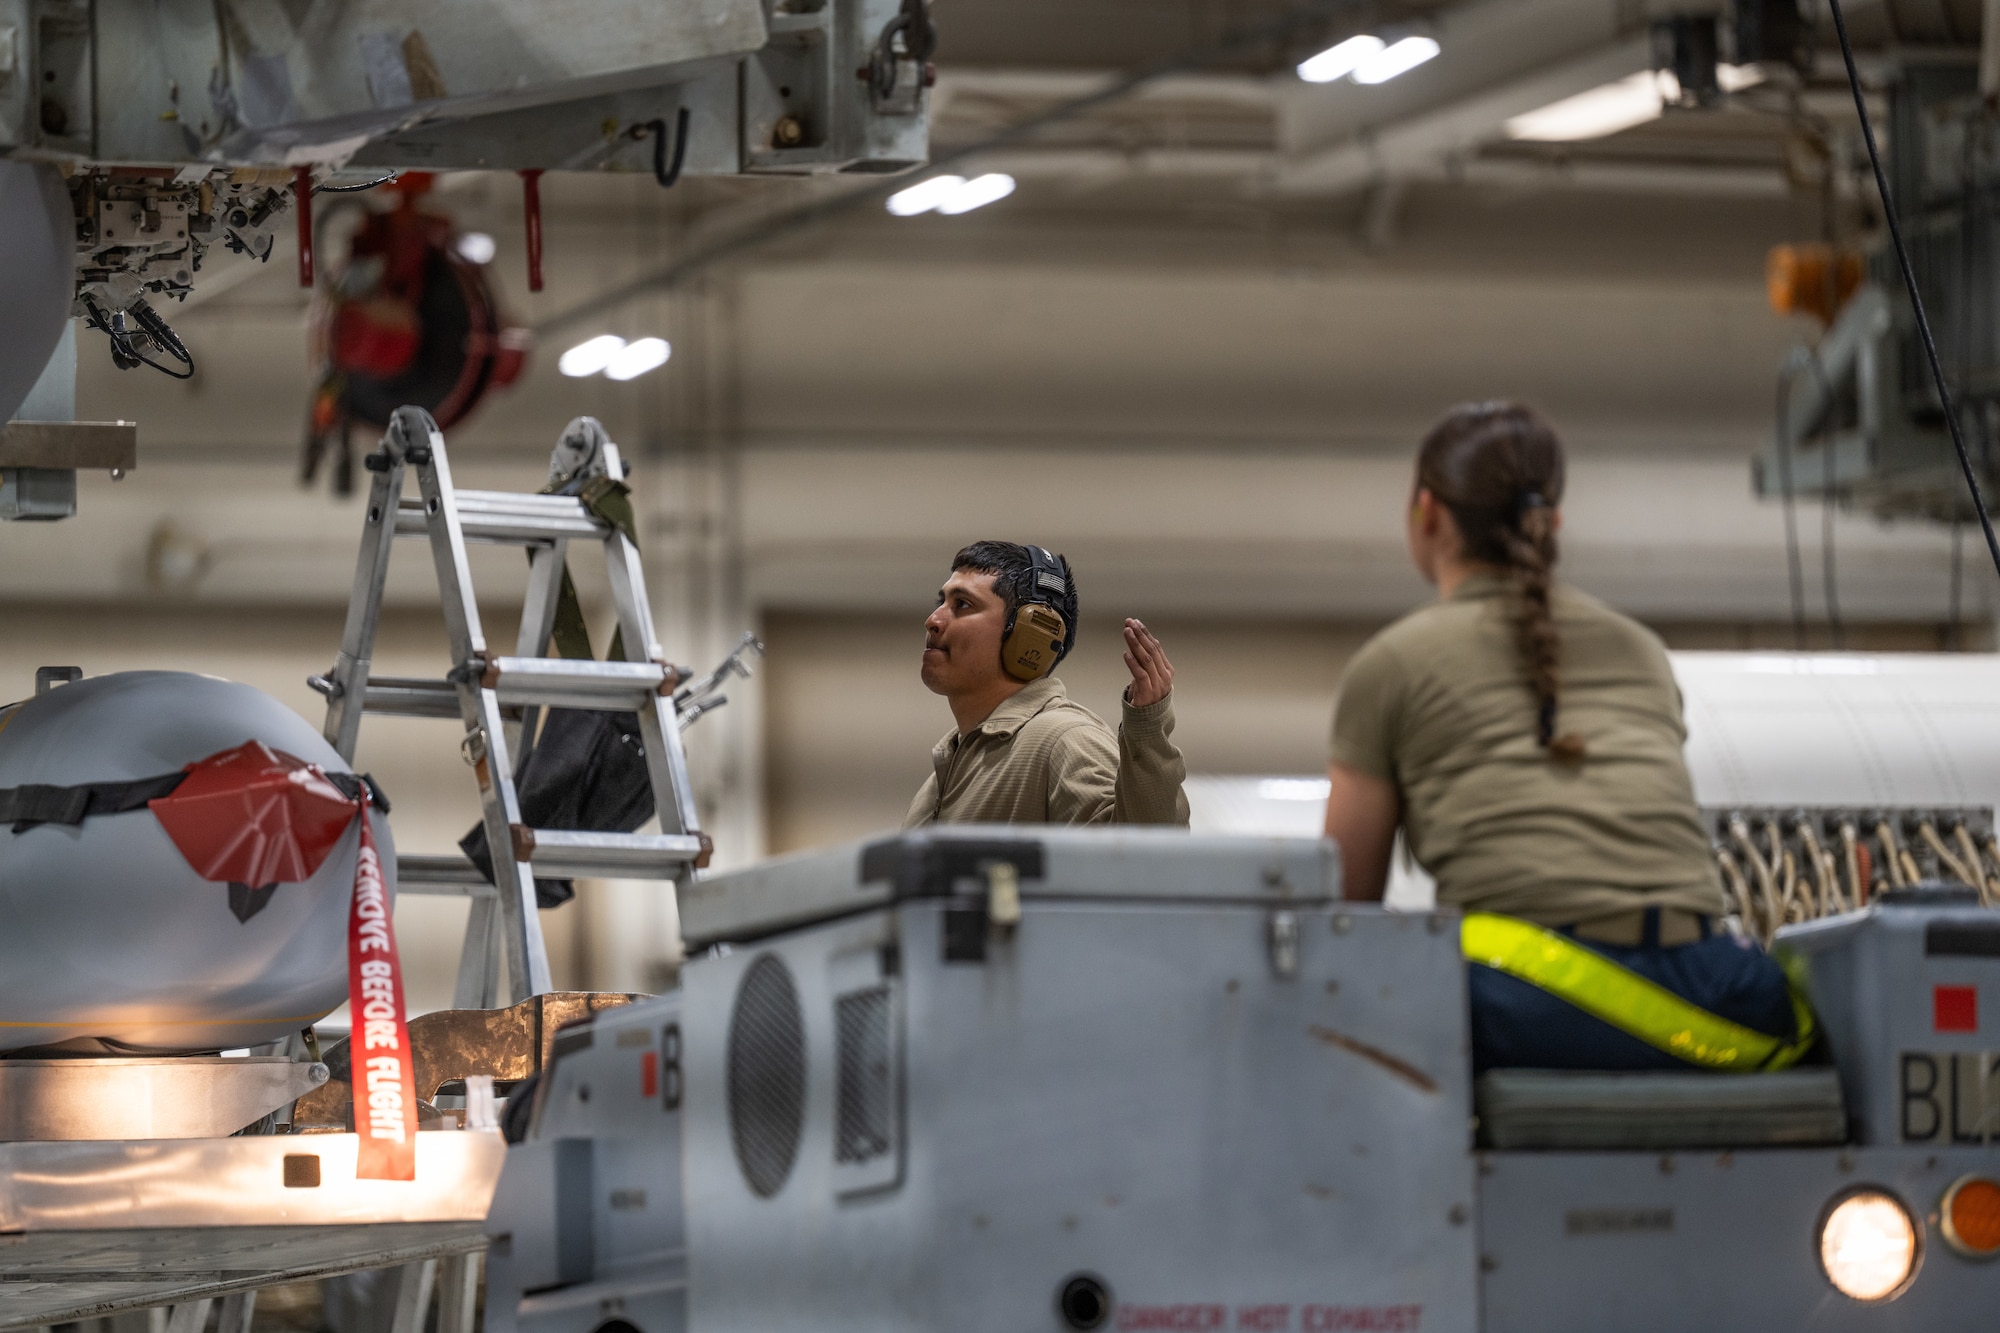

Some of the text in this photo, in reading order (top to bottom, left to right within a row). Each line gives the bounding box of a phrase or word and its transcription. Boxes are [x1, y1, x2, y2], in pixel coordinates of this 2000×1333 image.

[357, 847, 406, 1144] REMOVE BEFORE FLIGHT
